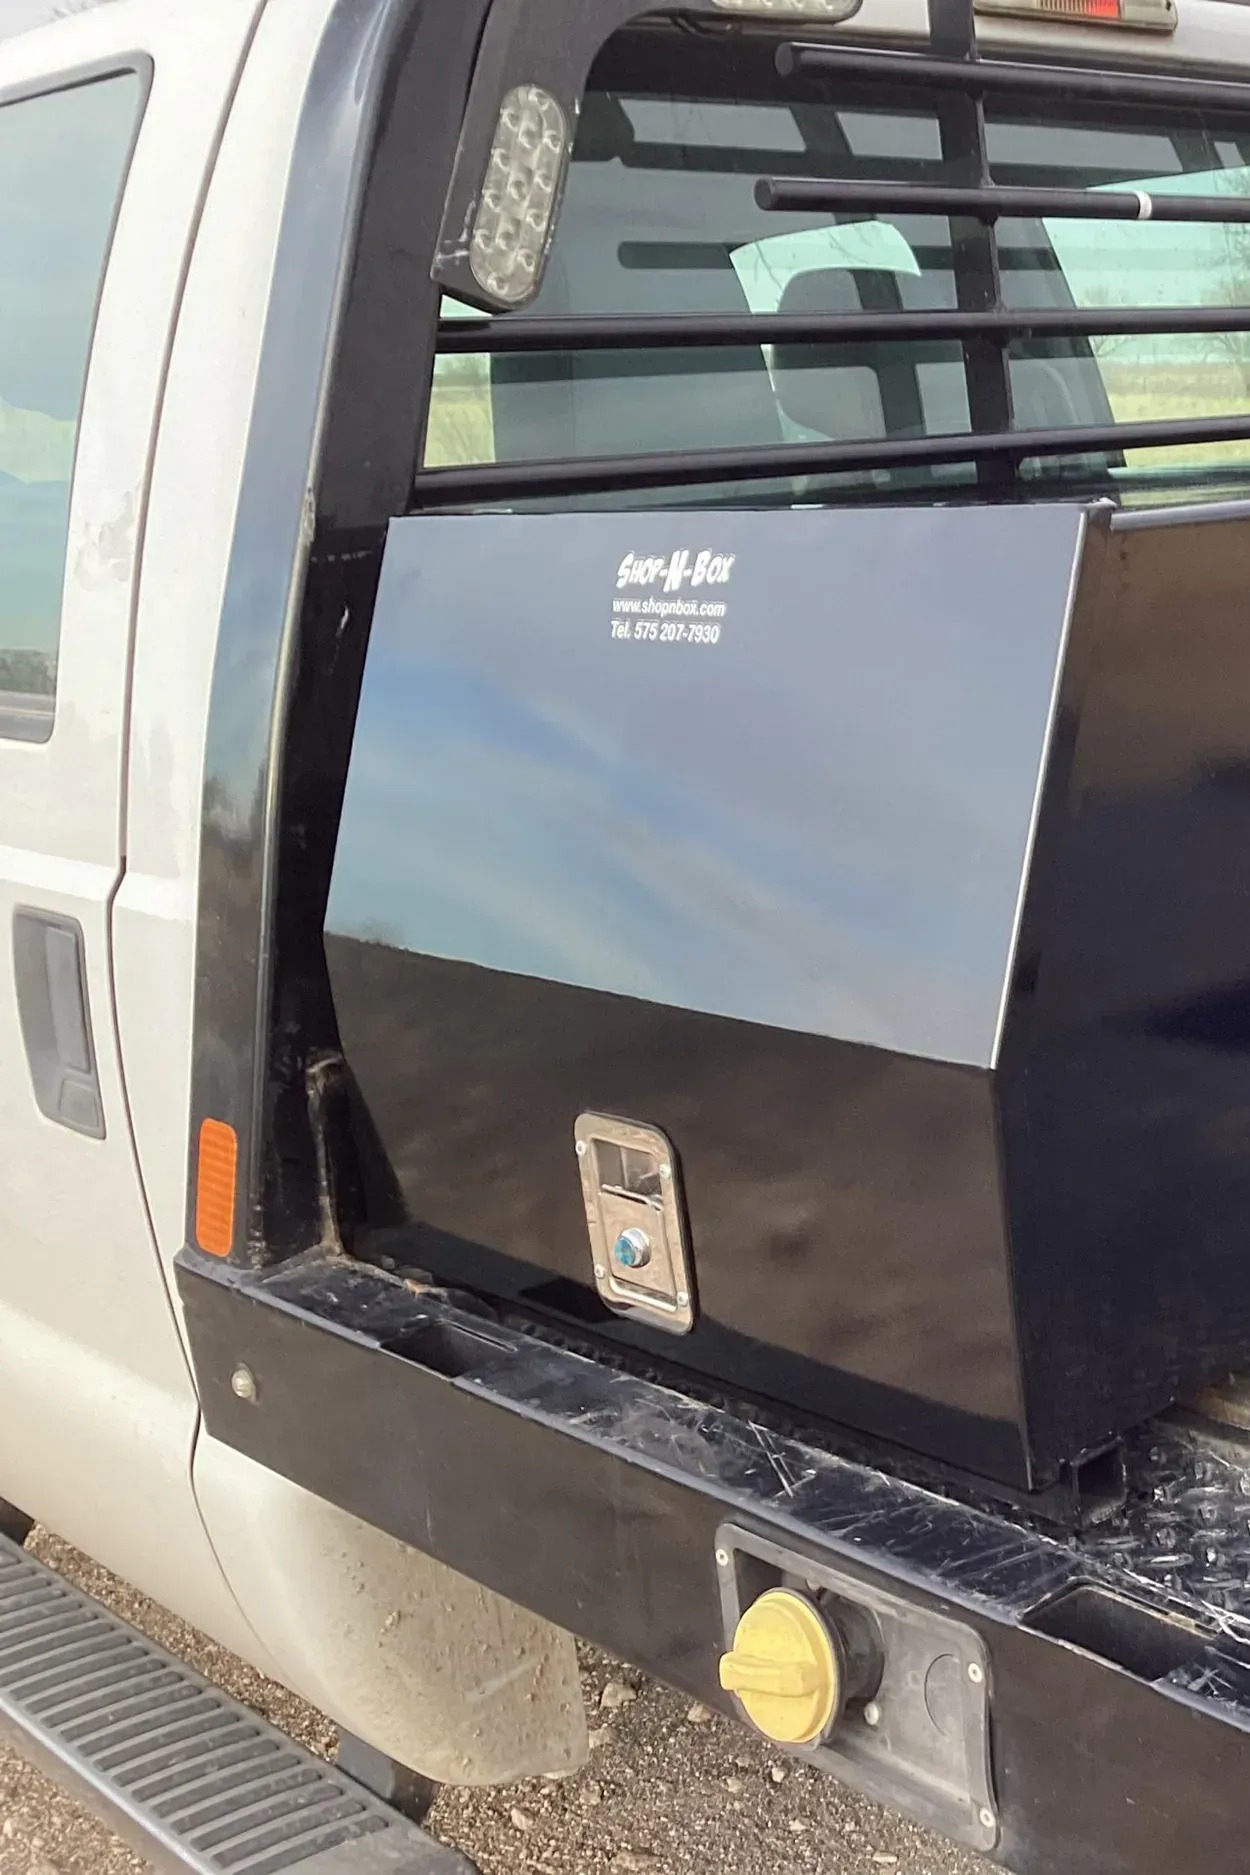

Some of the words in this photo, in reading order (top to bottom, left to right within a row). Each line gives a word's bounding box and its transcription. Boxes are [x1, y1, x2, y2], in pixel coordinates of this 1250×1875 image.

[612, 598, 726, 617] www.shopnbox.com
[610, 620, 631, 638] Tel.
[634, 621, 659, 640] 575
[659, 623, 720, 644] 207-7930
